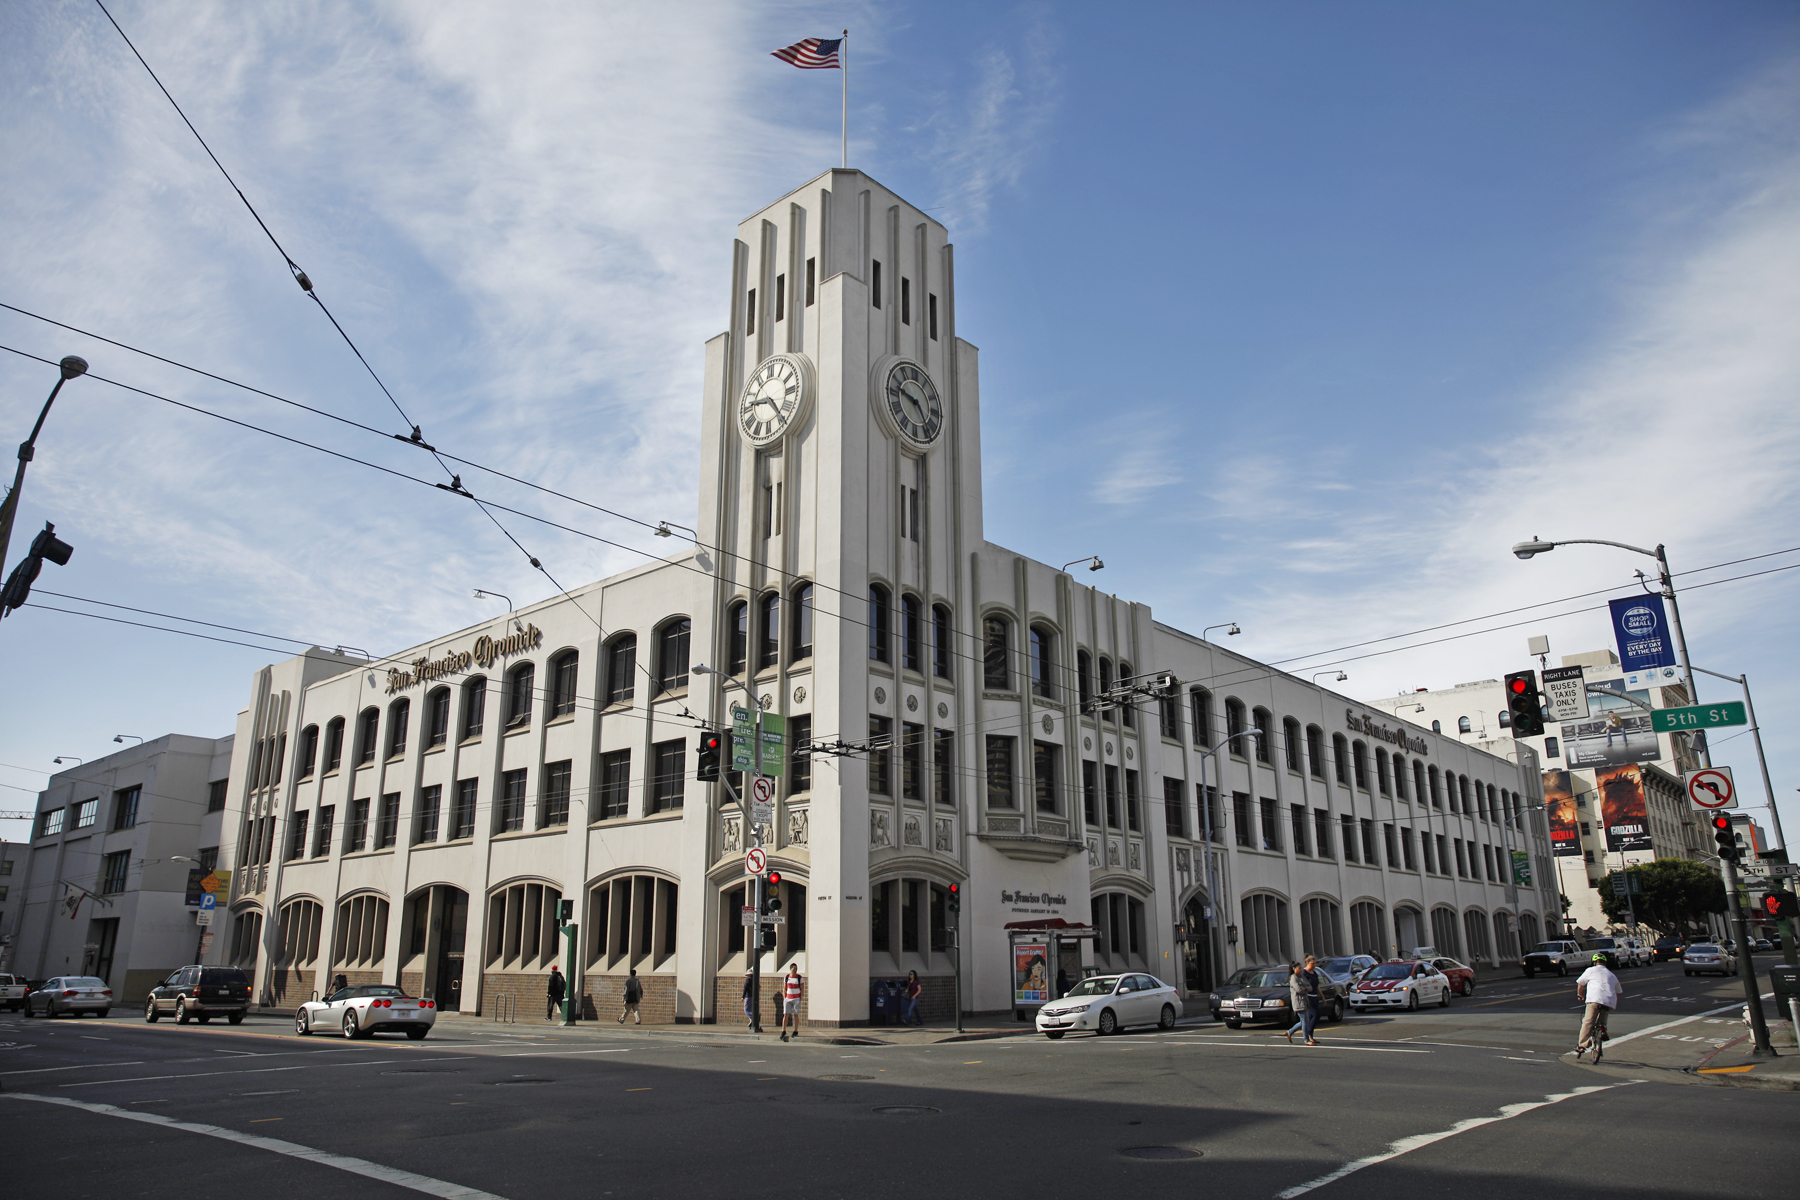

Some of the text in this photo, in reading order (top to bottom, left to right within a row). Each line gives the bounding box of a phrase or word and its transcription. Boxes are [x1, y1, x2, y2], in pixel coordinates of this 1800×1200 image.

[1628, 620, 1652, 628] SMALL
[1627, 643, 1648, 651] EVERY
[384, 622, 540, 694] San Francisco Chronicle
[1544, 669, 1581, 680] RIGHT LANE
[1550, 681, 1577, 691] BUSES
[1554, 690, 1577, 698] TAXIS
[1556, 698, 1577, 707] ONLY
[736, 712, 748, 721] en.
[1666, 709, 1729, 727] 5th St
[740, 725, 753, 735] tre.
[1346, 707, 1428, 756] San Francisco Chronicle
[1610, 824, 1644, 835] GODZILLA
[1743, 866, 1790, 876] 5TH ST
[1001, 889, 1067, 907] San Francisco Chronicle
[1358, 980, 1396, 988] 707
[1651, 1034, 1732, 1044] BUS
